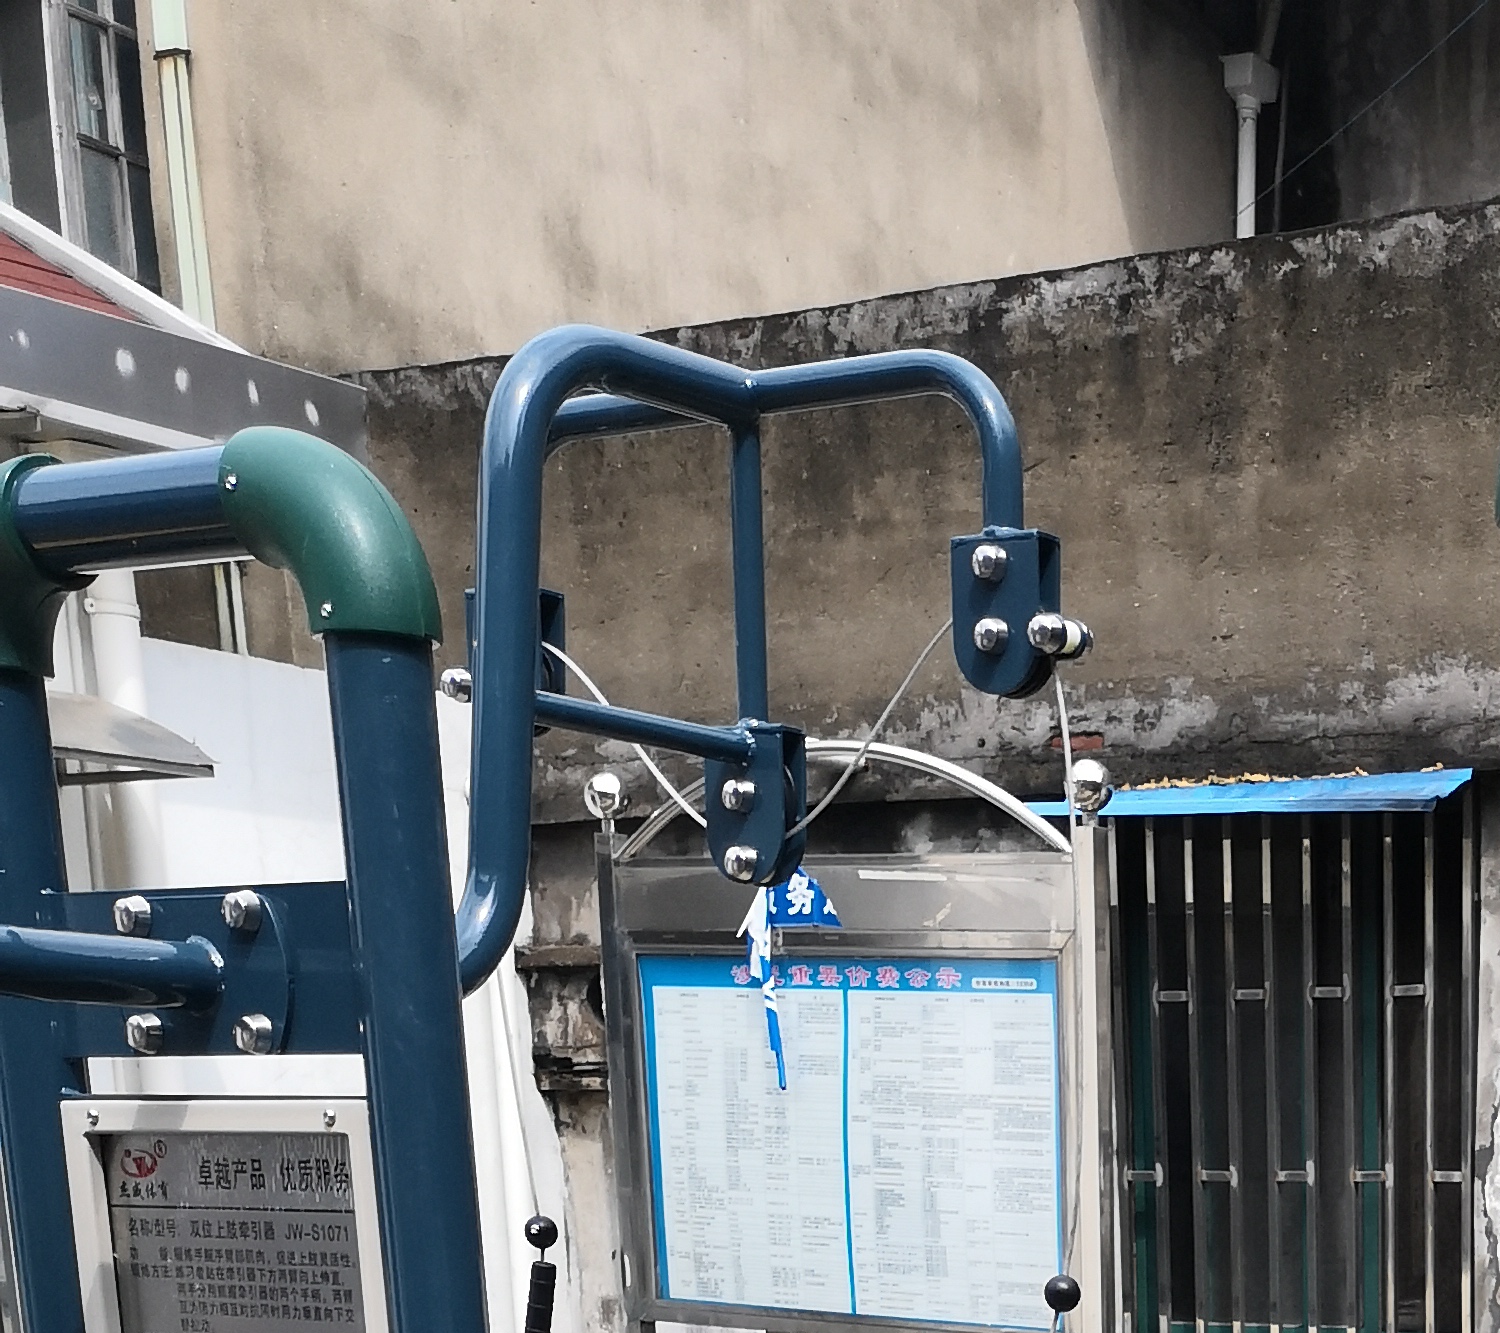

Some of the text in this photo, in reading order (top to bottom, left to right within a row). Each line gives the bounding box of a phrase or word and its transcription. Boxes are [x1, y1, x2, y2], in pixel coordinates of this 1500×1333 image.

[197, 1156, 266, 1191] 卓越产品
[284, 1223, 350, 1243] JW-S1071
